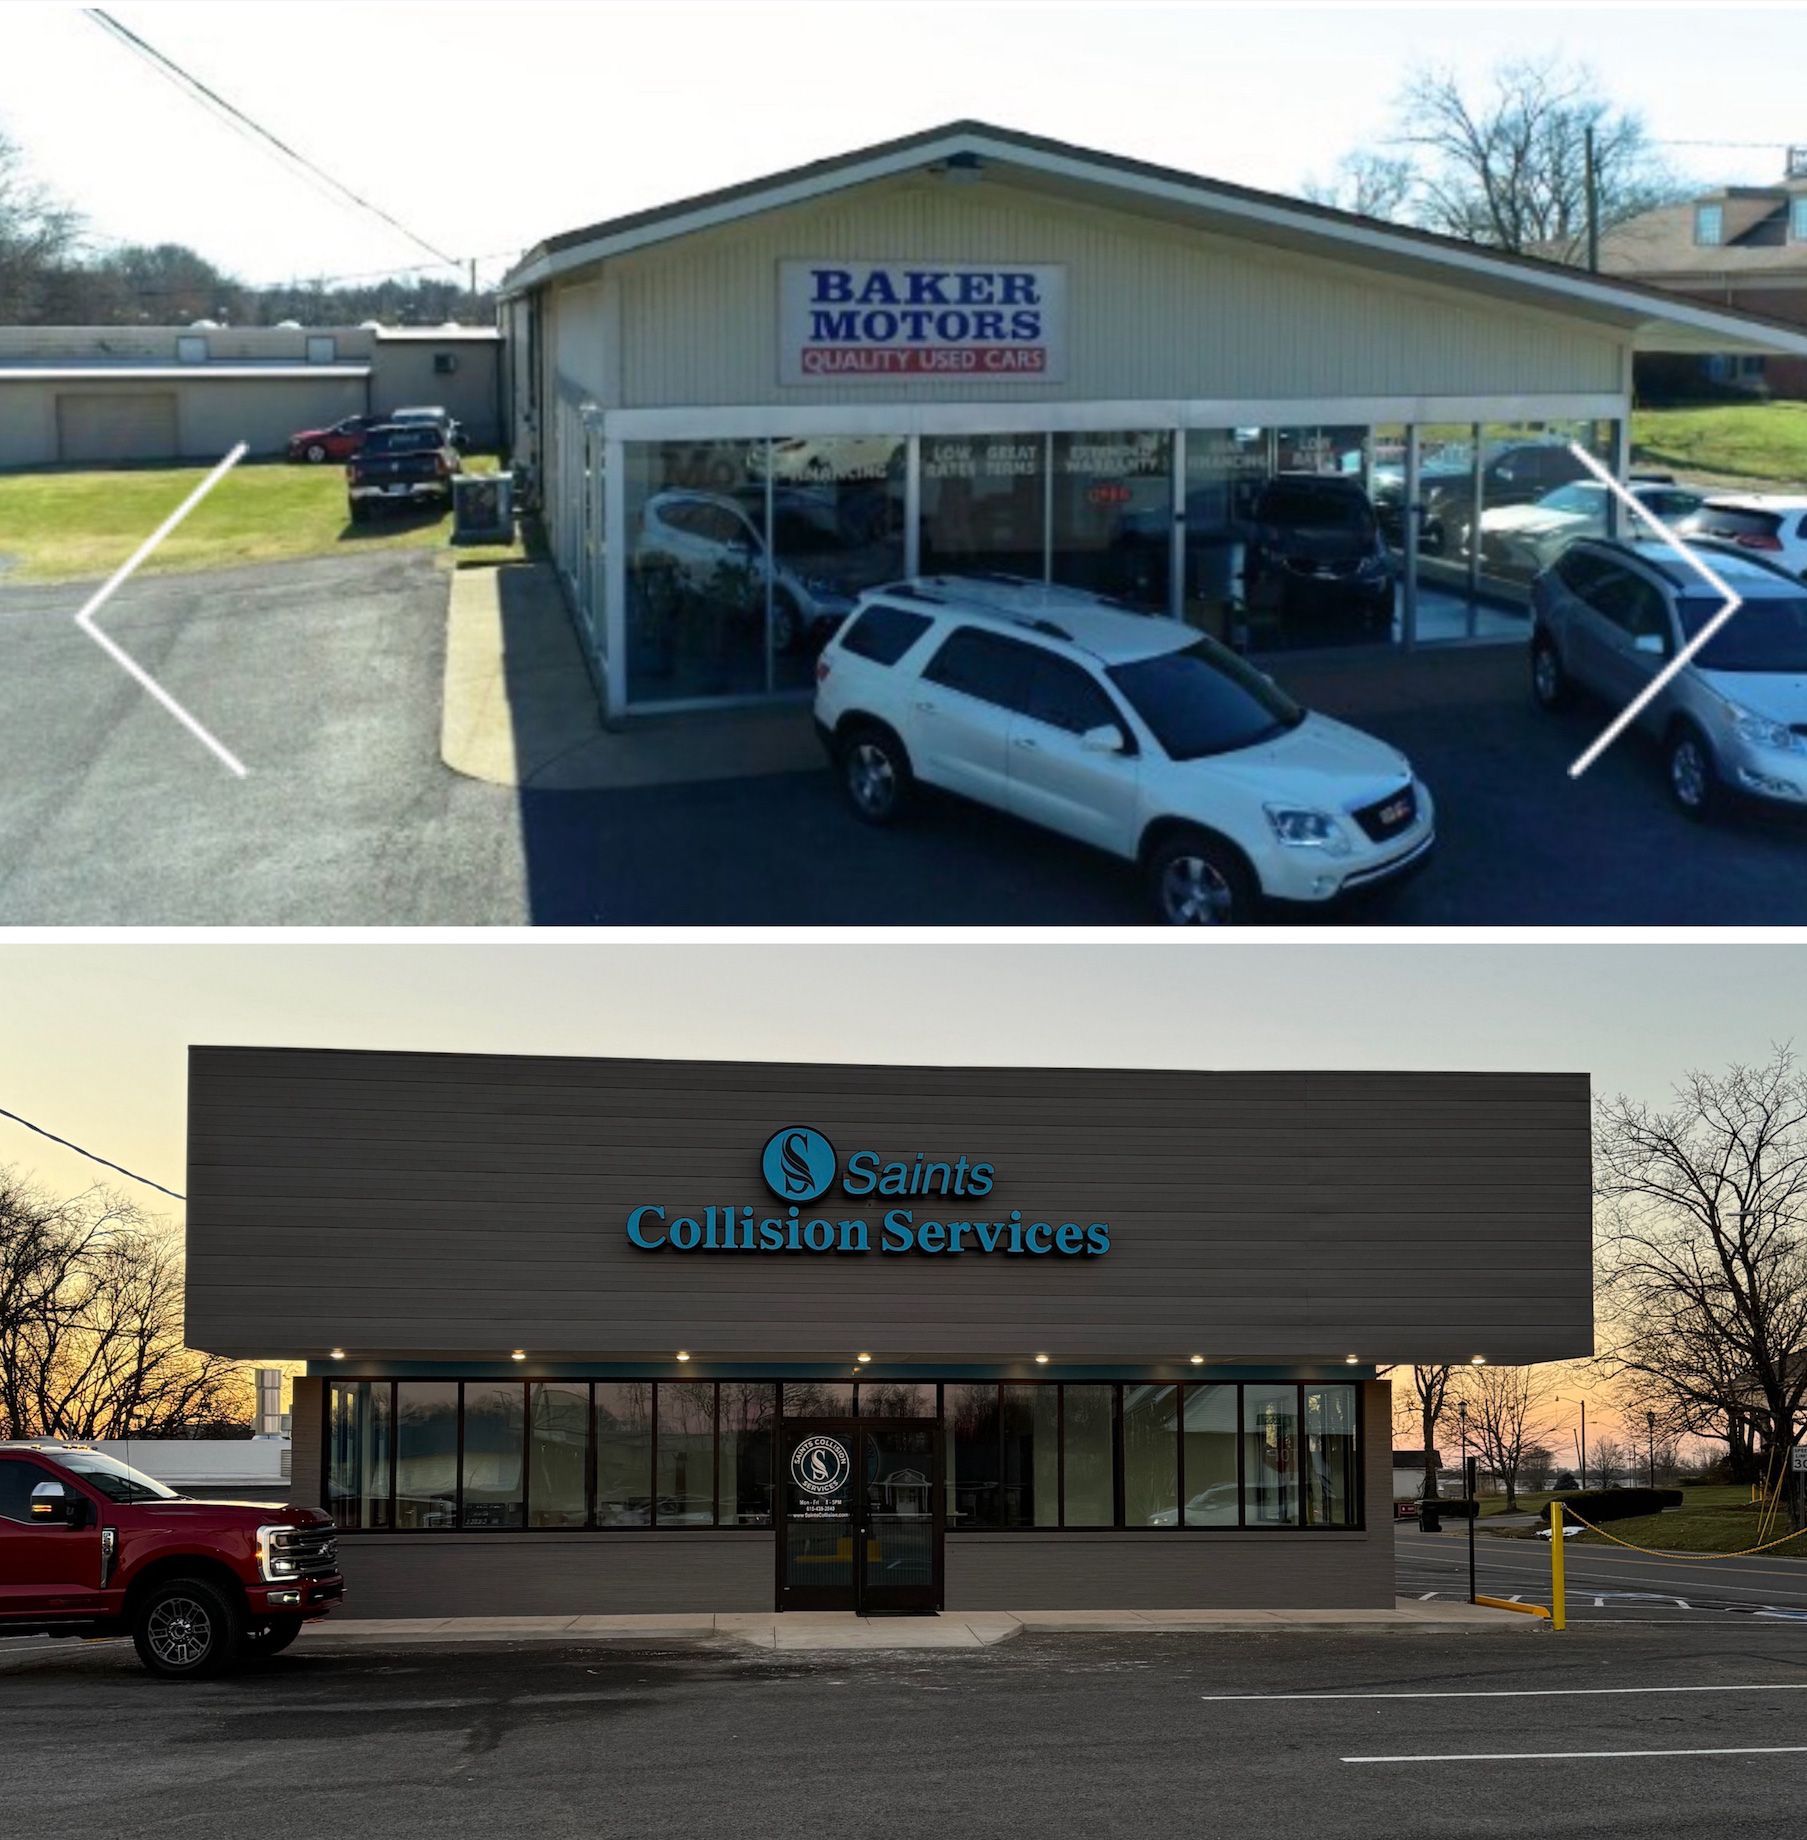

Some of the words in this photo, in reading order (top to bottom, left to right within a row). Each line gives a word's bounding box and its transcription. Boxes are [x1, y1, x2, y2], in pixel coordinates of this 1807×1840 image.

[810, 270, 1041, 305] BAKER
[809, 309, 1041, 342] MOTORS
[804, 350, 910, 373] QUALITY
[918, 350, 976, 370] USED
[983, 350, 1043, 369] CARS
[842, 1150, 995, 1197] Saints
[626, 1204, 871, 1252] Collision
[881, 1209, 1111, 1256] Services
[794, 1440, 814, 1465] SAINTS
[814, 1439, 847, 1465] COLLISION
[802, 1480, 839, 1492] SERVICES
